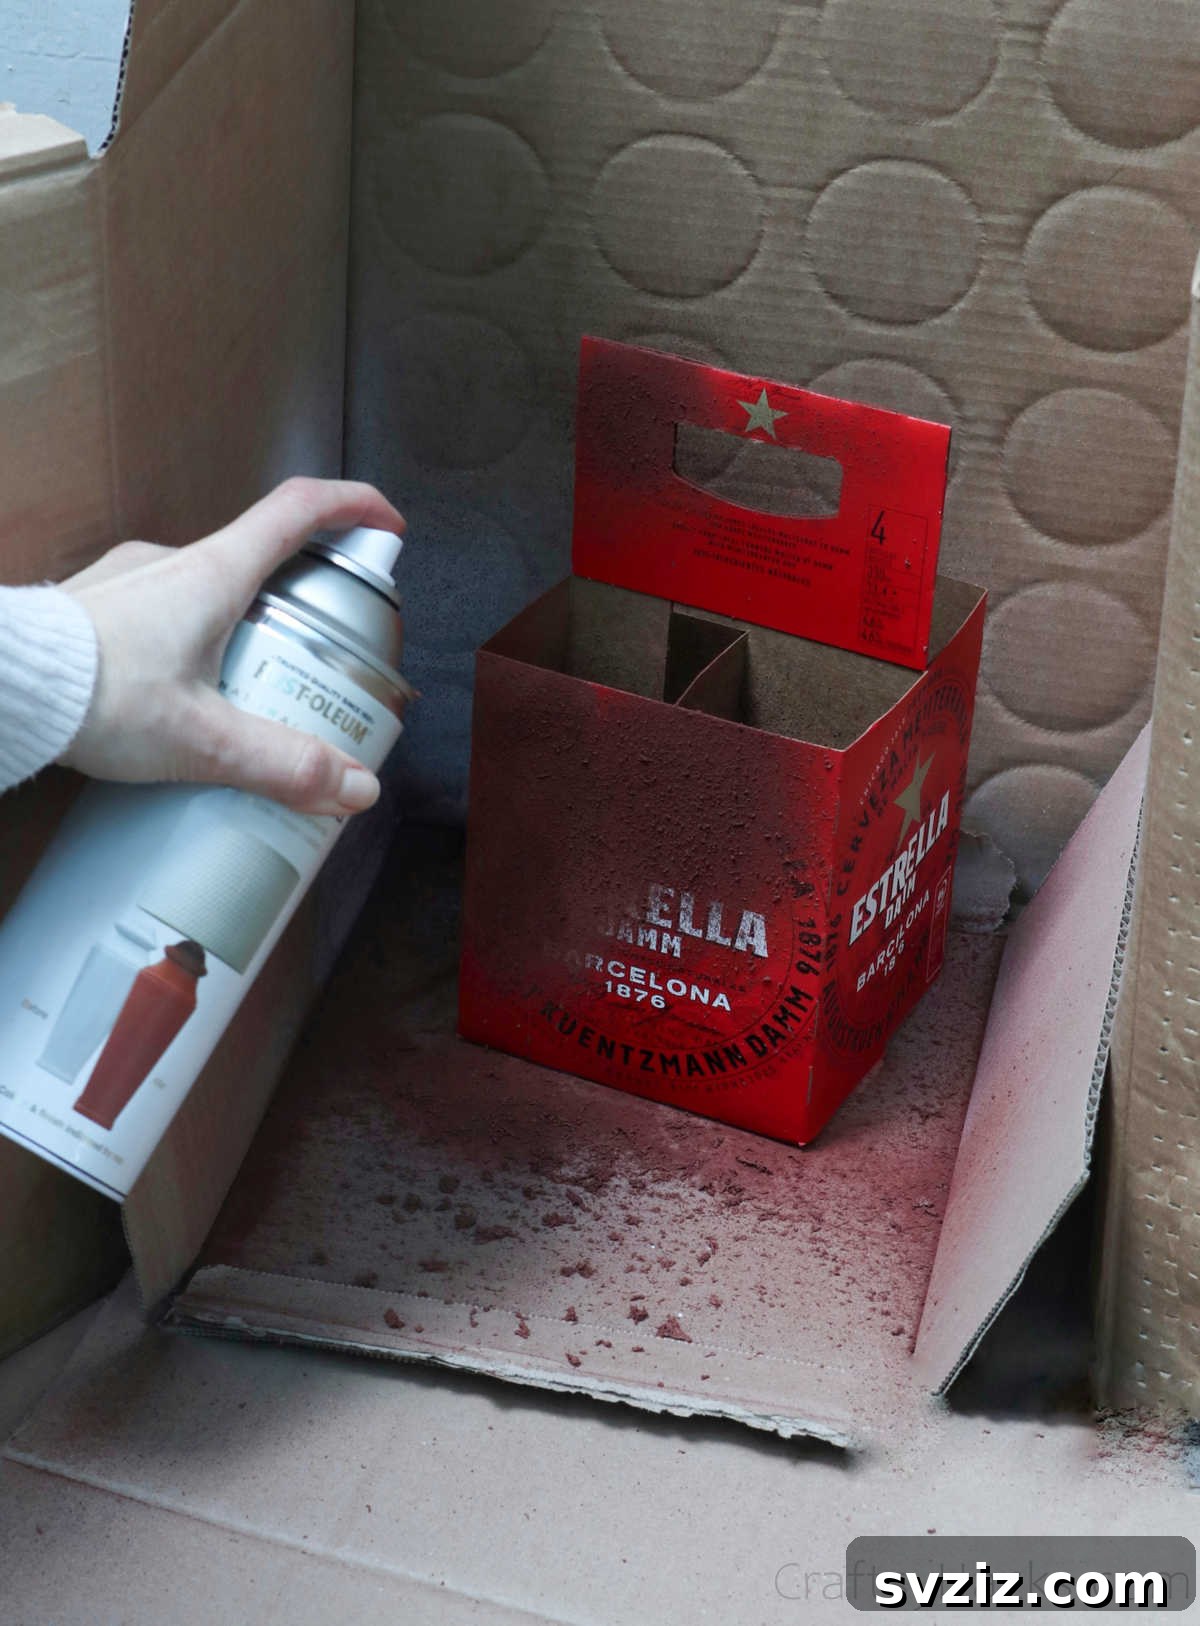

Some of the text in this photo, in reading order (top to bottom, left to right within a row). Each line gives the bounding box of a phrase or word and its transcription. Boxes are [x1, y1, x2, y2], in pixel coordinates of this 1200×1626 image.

[870, 510, 886, 545] 4
[849, 789, 950, 946] ESTRELLA
[647, 883, 769, 959] ELLA
[584, 952, 731, 1012] RCELONA
[605, 980, 666, 1009] 1876
[541, 1003, 747, 1077] KUENTZMANN
[745, 985, 814, 1058] DAMM
